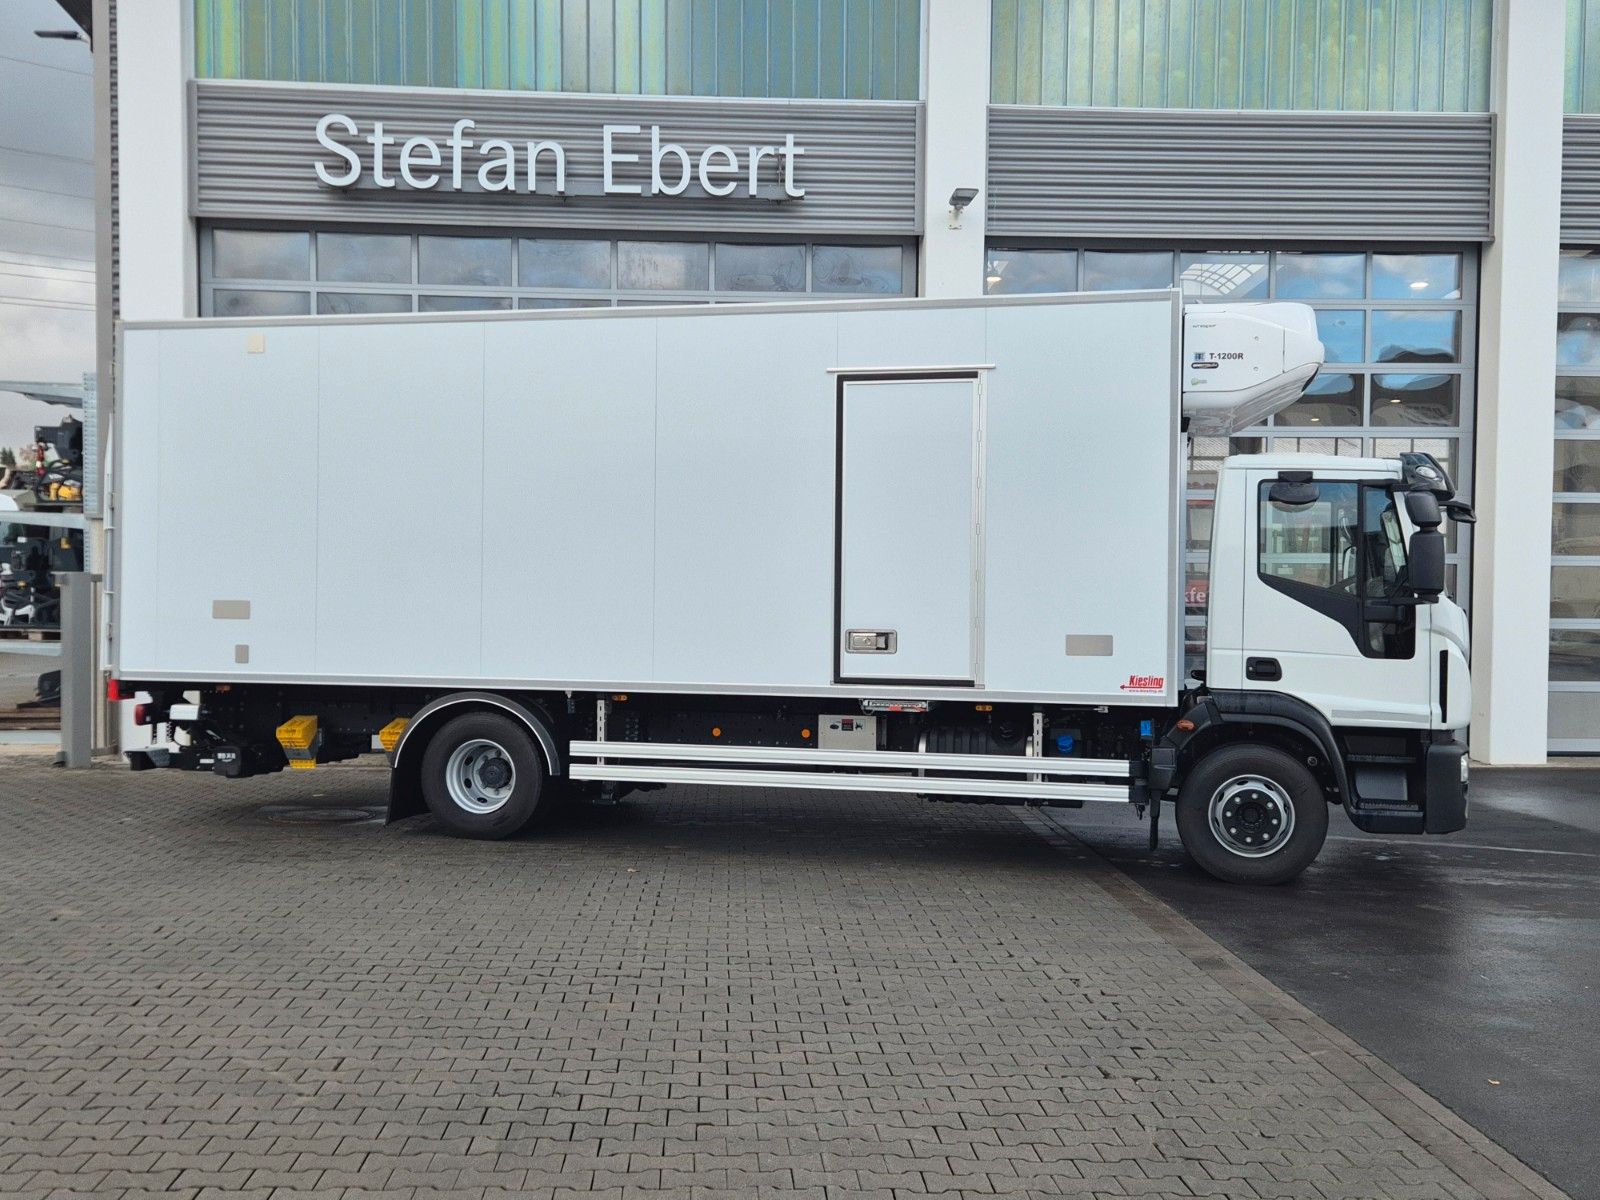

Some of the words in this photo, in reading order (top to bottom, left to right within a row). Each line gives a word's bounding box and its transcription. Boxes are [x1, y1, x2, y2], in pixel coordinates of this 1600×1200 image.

[314, 113, 565, 192] Stefan
[603, 124, 806, 197] Ebert
[1209, 352, 1244, 360] T-1200R
[1129, 675, 1164, 688] Kiesling
